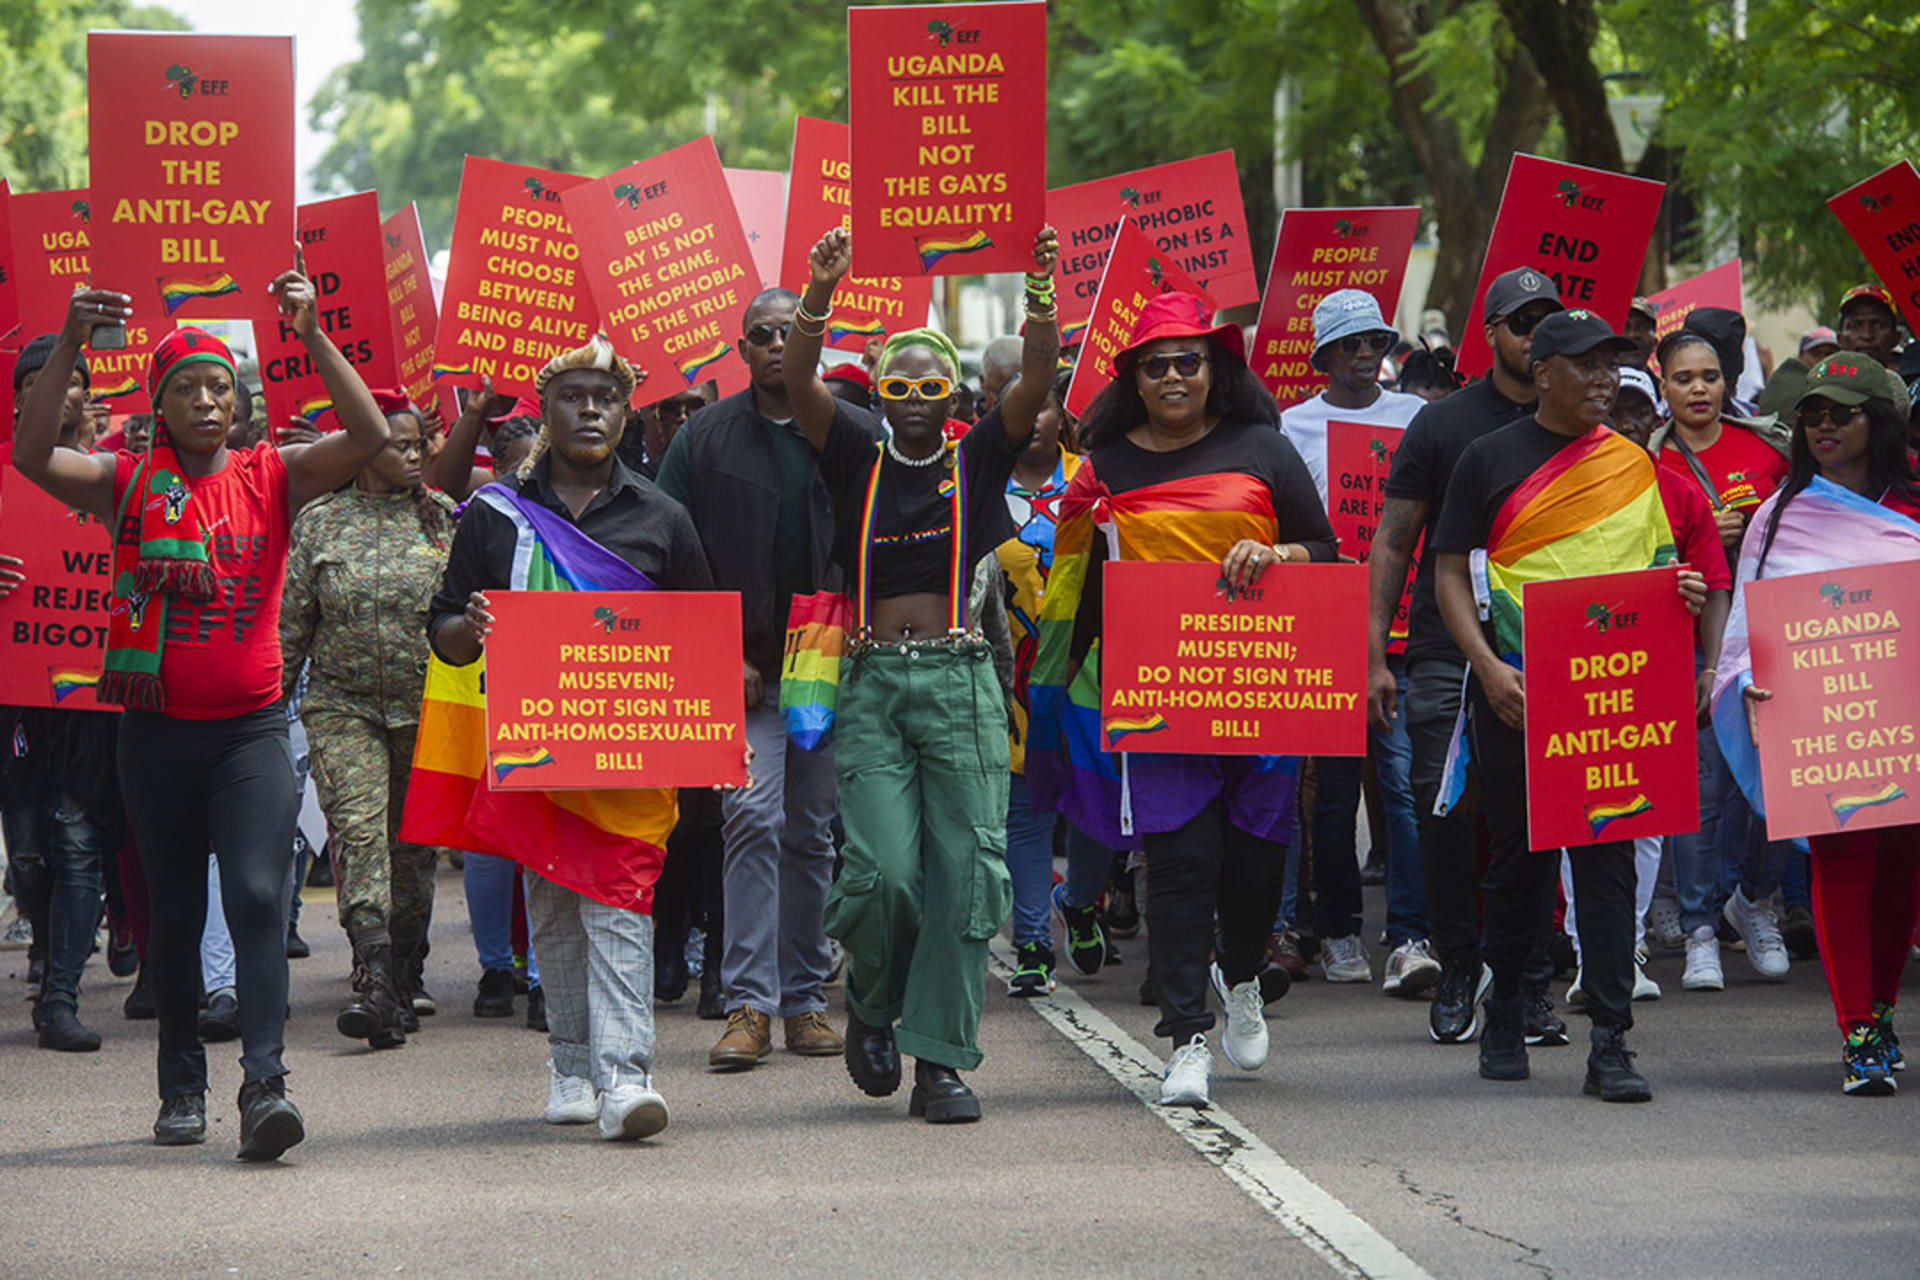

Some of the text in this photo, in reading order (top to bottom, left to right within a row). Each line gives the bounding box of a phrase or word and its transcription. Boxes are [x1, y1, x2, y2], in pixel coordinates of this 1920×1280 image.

[957, 29, 981, 44] EFF
[887, 53, 1005, 77] UGANDA
[200, 80, 229, 96] EFF
[893, 83, 999, 106] KILL THE
[145, 120, 239, 146] DROP
[921, 115, 971, 135] BILL
[918, 144, 975, 166] NOT
[162, 160, 220, 185] THE
[885, 172, 1008, 197] THE GAYS
[644, 181, 668, 200] EFF
[822, 185, 851, 206] KIL
[112, 199, 272, 225] ANTI-GAY
[880, 202, 1012, 228] EQUALITY!
[1072, 200, 1215, 247] HOMPHOBIC
[43, 231, 90, 249] UGA
[304, 228, 326, 244] EFF
[624, 211, 684, 246] BEING
[1195, 227, 1213, 244] IS
[1219, 223, 1234, 238] A
[161, 238, 225, 263] BILL
[479, 228, 579, 261] MUST NO
[608, 223, 716, 277] GAY IS NOT
[1312, 246, 1379, 263] PEOPLE
[1538, 232, 1599, 263] END
[386, 251, 414, 280] GANDA
[487, 256, 575, 286] CHOOSE
[617, 249, 720, 298] THE CRIME,
[1291, 269, 1389, 286] MUST NOT
[478, 279, 575, 312] BETWEEN
[608, 262, 745, 326] HOMOPHOBIA
[1551, 271, 1597, 300] ATE
[278, 306, 352, 343] HTE
[458, 302, 588, 340] BEING ALIVE
[631, 289, 738, 343] IS THE TRUE
[1111, 298, 1139, 327] GAY
[458, 328, 506, 353] AND
[663, 321, 722, 354] CRIME
[1107, 318, 1132, 347] THE
[266, 340, 373, 383] CRIES
[472, 356, 541, 383] IN LOV
[1094, 355, 1107, 375] IS
[1264, 362, 1308, 377] AND
[1828, 362, 1859, 379] EFF
[1276, 384, 1299, 399] IN
[1340, 473, 1373, 490] GAY
[1339, 498, 1369, 515] ARE
[215, 535, 265, 560] EFF
[61, 550, 110, 575] WE
[1849, 589, 1872, 604] EFF
[165, 608, 256, 642] EFF
[619, 618, 641, 631] EFF
[1180, 614, 1295, 632] PRESIDENT
[1615, 612, 1640, 628] EFF
[1784, 609, 1901, 641] UGANDA
[12, 621, 109, 649] BIGOT
[560, 645, 671, 663] PRESIDENT
[1177, 640, 1297, 661] MUSEVENI;
[1792, 639, 1898, 670] KILL THE
[1137, 666, 1333, 686] DO NOT SIGN THE
[1570, 651, 1648, 681] DROP
[558, 671, 675, 692] MUSEVENI;
[1822, 671, 1872, 695] BILL
[521, 698, 711, 716] DO NOT SIGN THE
[1111, 689, 1358, 710] ANTI-HOMOSEXUALITY
[1584, 689, 1634, 716] THE
[1822, 699, 1877, 724] NOT
[497, 722, 736, 741] ANTI-HOMOSEXUALITY
[1210, 720, 1260, 737] BILL!
[1544, 720, 1677, 758] ANTI-GAY
[1792, 725, 1914, 757] THE GAYS
[595, 752, 643, 771] BILL!
[1790, 753, 1920, 787] EQUALITY!
[1585, 762, 1640, 790] BILL
